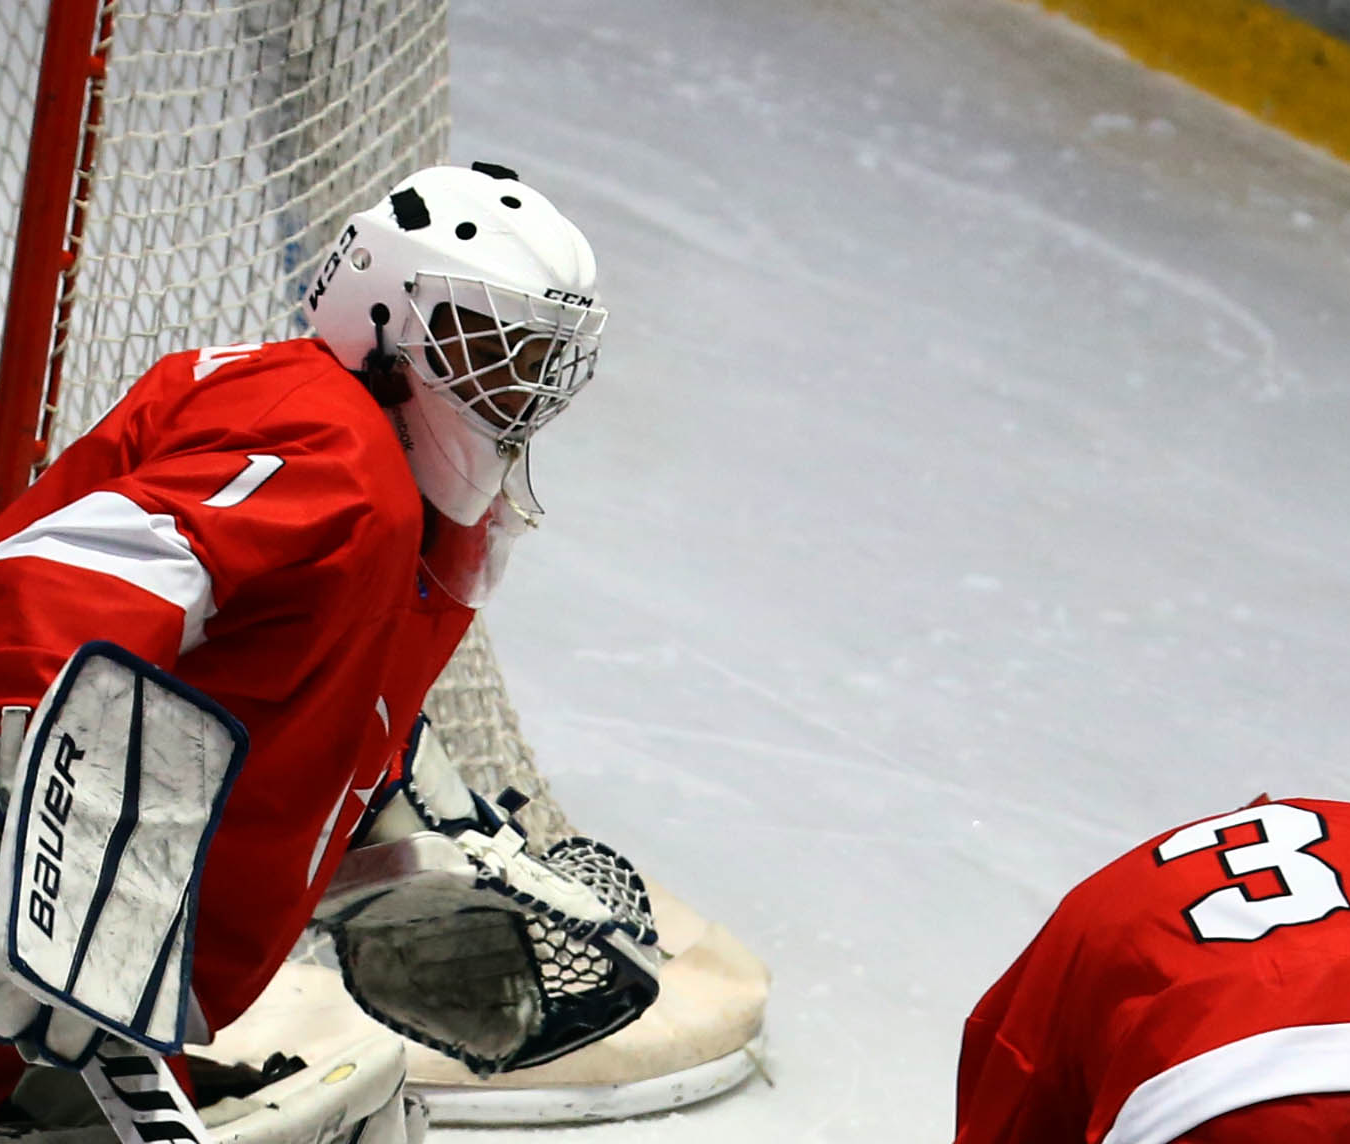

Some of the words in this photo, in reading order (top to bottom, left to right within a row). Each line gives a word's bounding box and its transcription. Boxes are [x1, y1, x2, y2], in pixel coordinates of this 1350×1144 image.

[308, 223, 358, 311] CCM
[543, 287, 594, 309] CCM
[201, 453, 287, 507] 1
